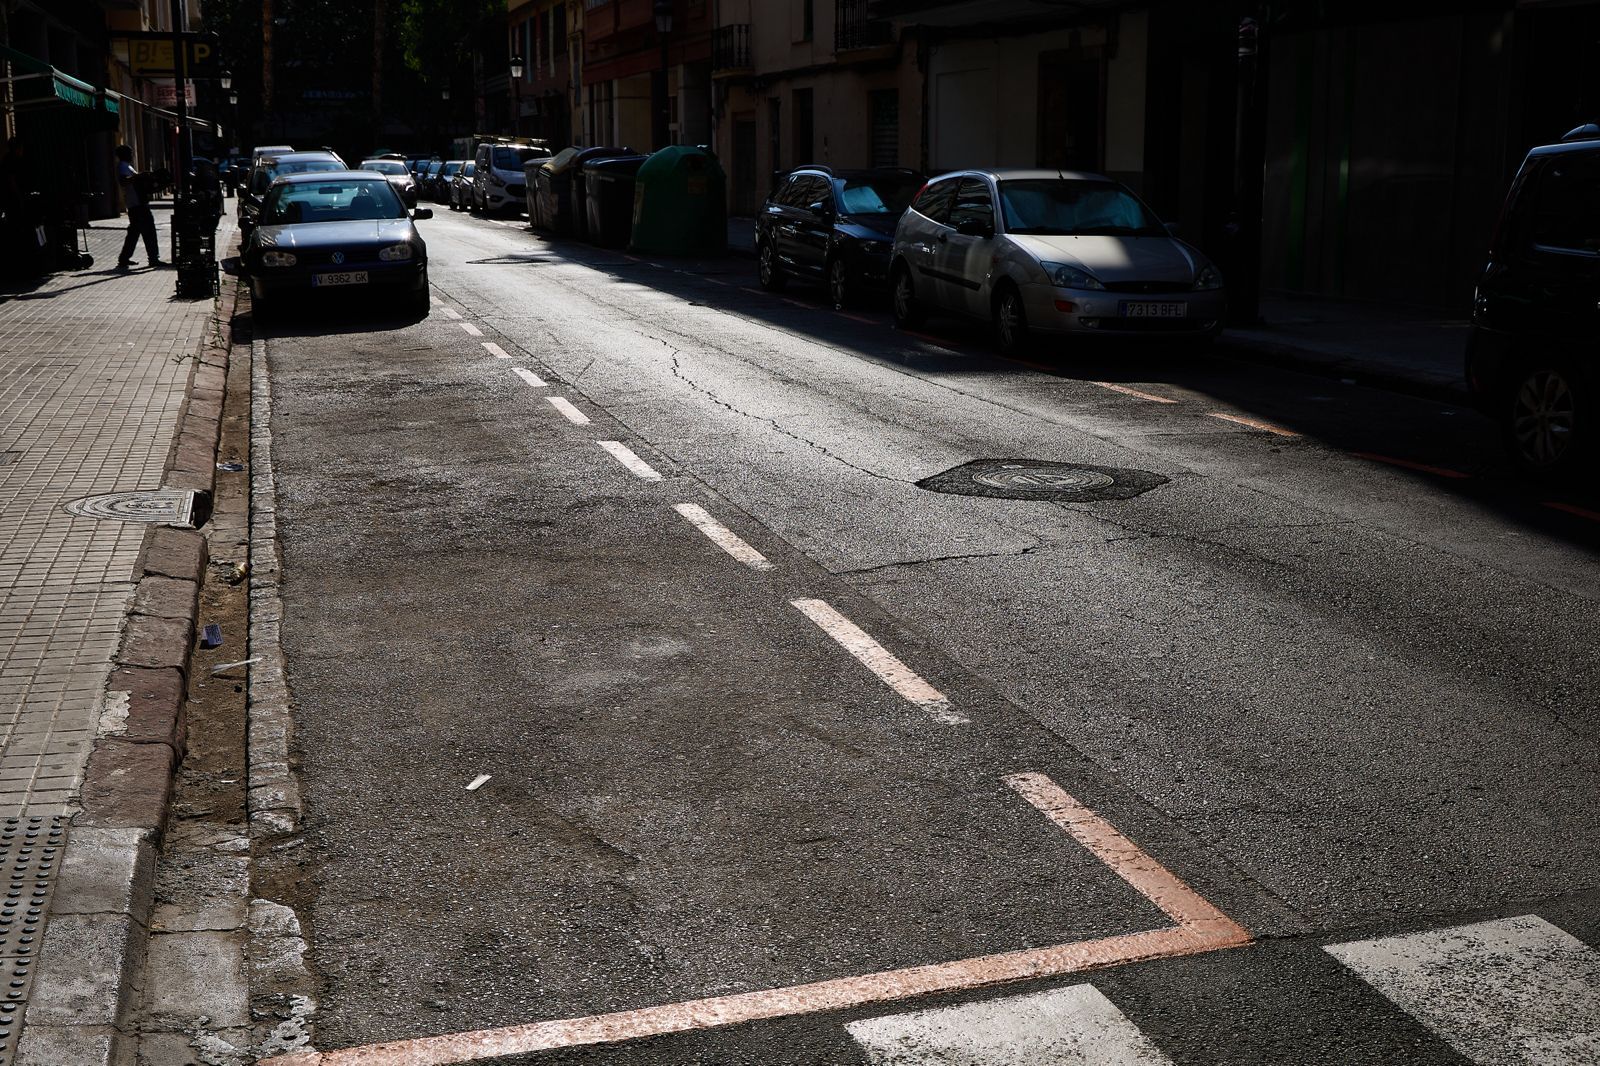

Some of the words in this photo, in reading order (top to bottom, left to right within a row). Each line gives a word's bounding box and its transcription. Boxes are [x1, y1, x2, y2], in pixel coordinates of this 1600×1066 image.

[194, 43, 211, 65] P
[317, 275, 323, 285] V
[327, 274, 351, 284] 9362
[355, 273, 367, 282] GK
[1127, 303, 1158, 316] 7313
[1161, 303, 1182, 316] BFL
